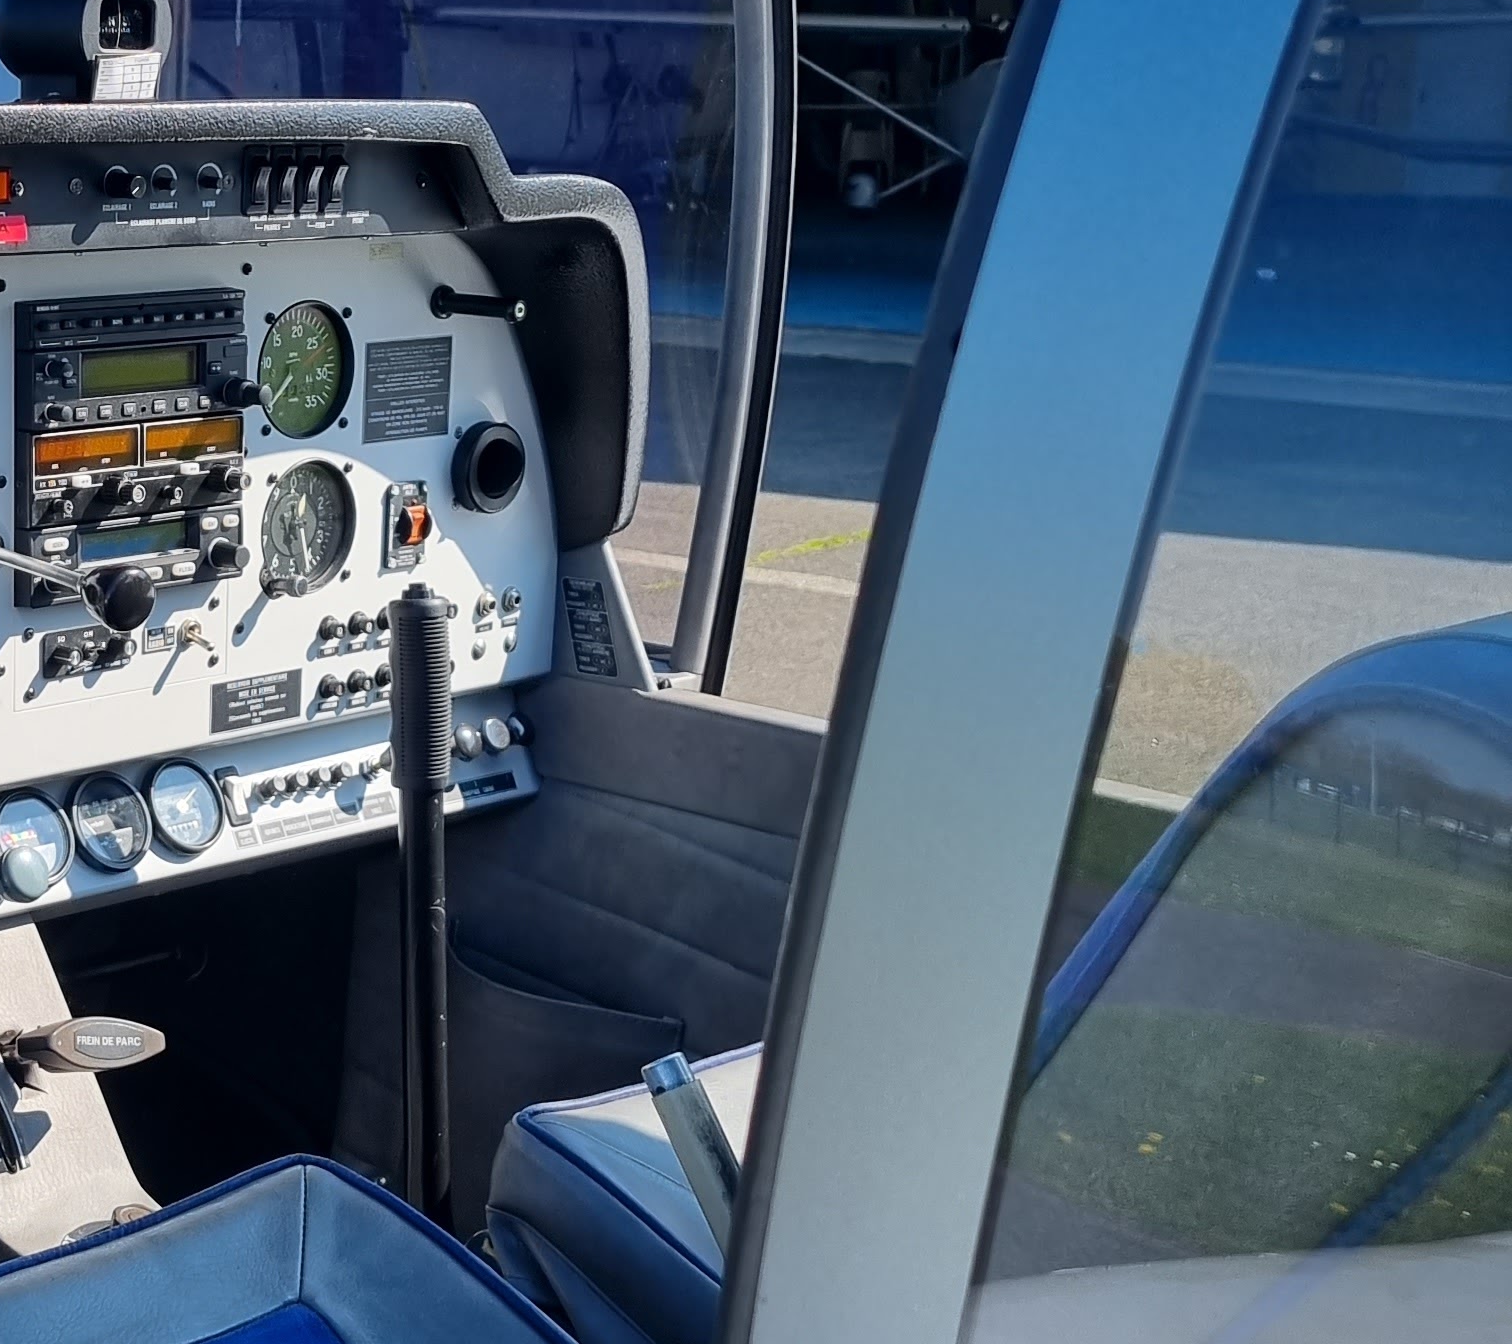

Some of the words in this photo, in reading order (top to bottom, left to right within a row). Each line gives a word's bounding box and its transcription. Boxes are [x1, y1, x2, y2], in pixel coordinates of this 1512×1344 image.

[292, 325, 303, 338] 20
[273, 334, 281, 347] 15
[307, 336, 318, 350] 25
[264, 357, 272, 369] 10
[316, 368, 328, 380] 30
[305, 395, 317, 408] 35
[290, 476, 297, 489] 0
[317, 497, 324, 510] 2
[317, 530, 324, 544] 3
[272, 554, 279, 568] 6
[289, 558, 296, 572] 5
[77, 1036, 100, 1046] FREIN
[102, 1037, 115, 1046] DE
[116, 1037, 142, 1047] PARC
